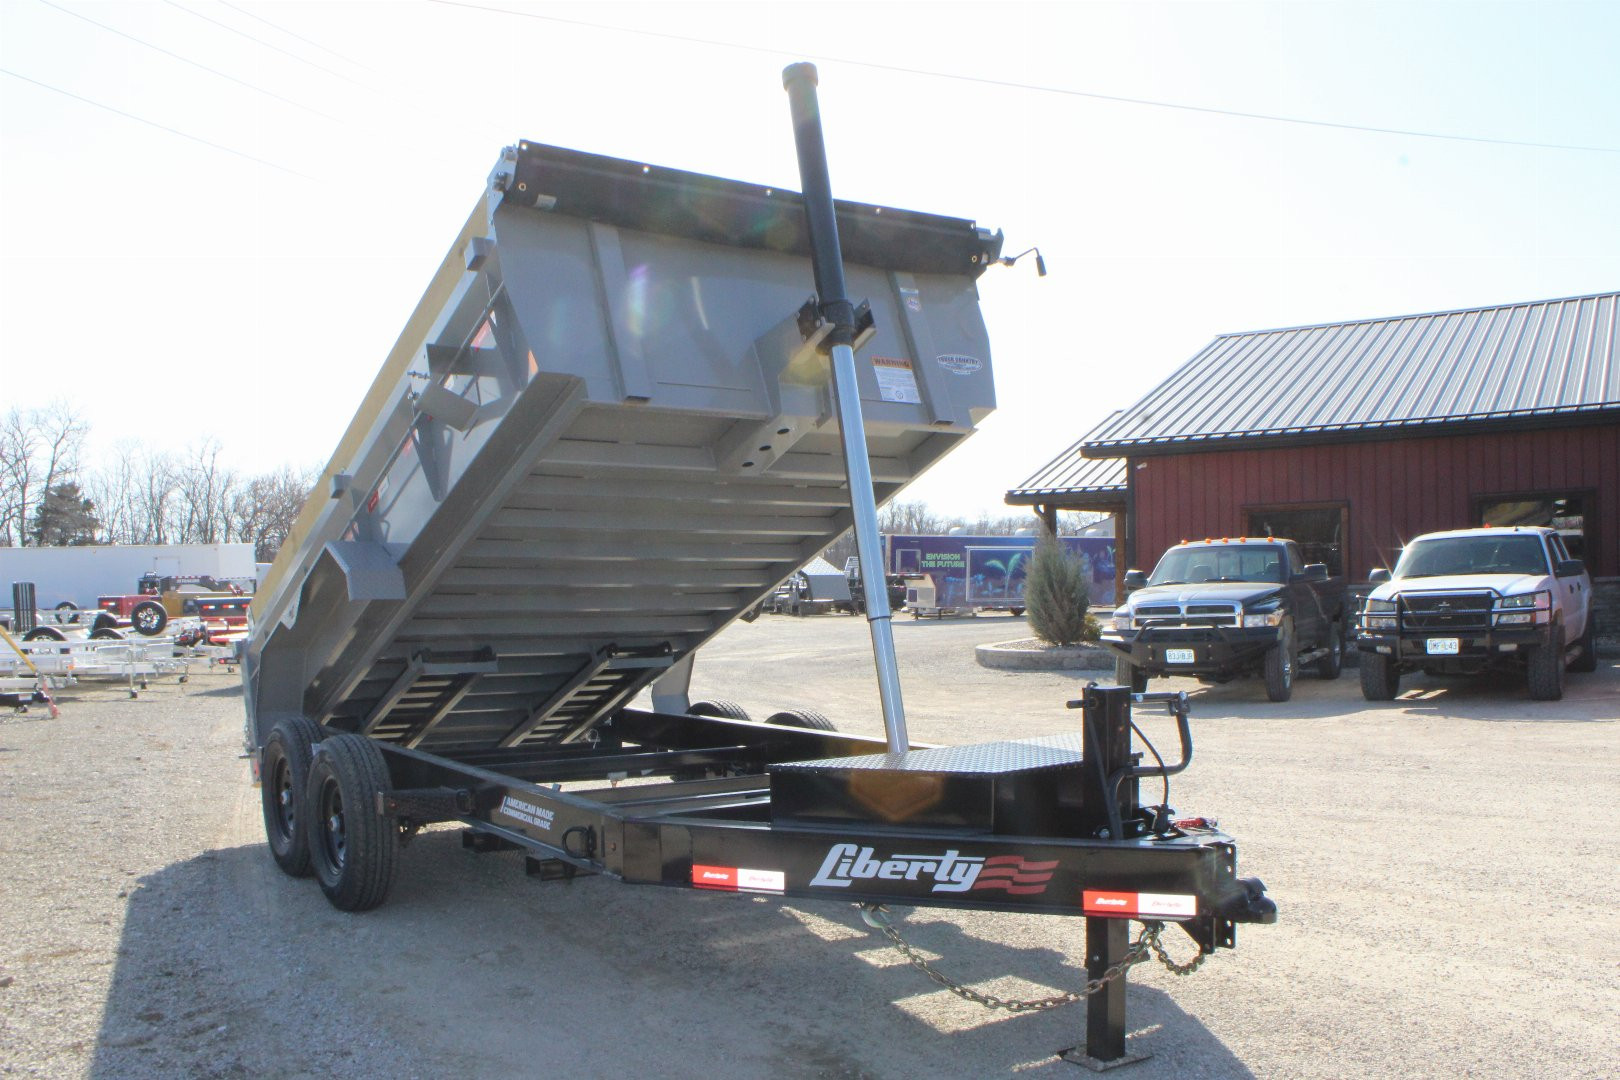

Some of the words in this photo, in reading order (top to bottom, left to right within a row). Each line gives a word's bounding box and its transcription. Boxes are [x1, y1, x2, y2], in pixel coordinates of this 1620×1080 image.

[921, 560, 936, 568] THE
[937, 560, 965, 568] FUTURE
[926, 553, 960, 561] ENVISION
[503, 807, 533, 825] COMMERCIAL
[533, 817, 551, 830] GRADE
[506, 796, 536, 815] AMERICAN
[536, 806, 555, 821] MADE
[809, 843, 986, 893] Liberty
